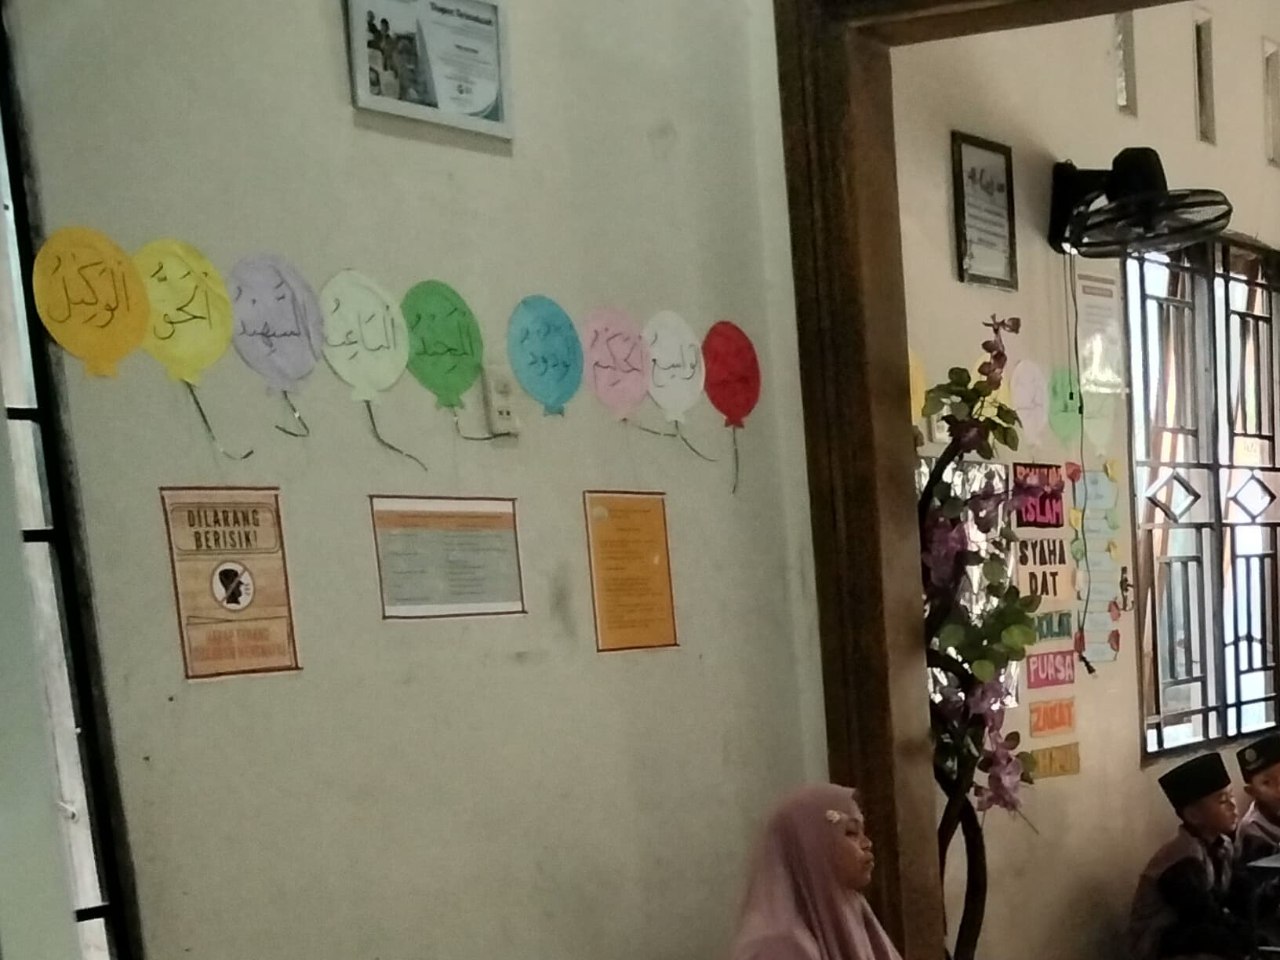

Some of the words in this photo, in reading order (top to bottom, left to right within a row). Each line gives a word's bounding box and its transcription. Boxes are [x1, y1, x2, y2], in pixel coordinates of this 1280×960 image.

[187, 509, 260, 528] DILARANG
[194, 531, 258, 550] BERISIK!
[1019, 539, 1066, 566] SYAHA
[1029, 571, 1059, 597] DAT
[1029, 654, 1074, 683] PUASA
